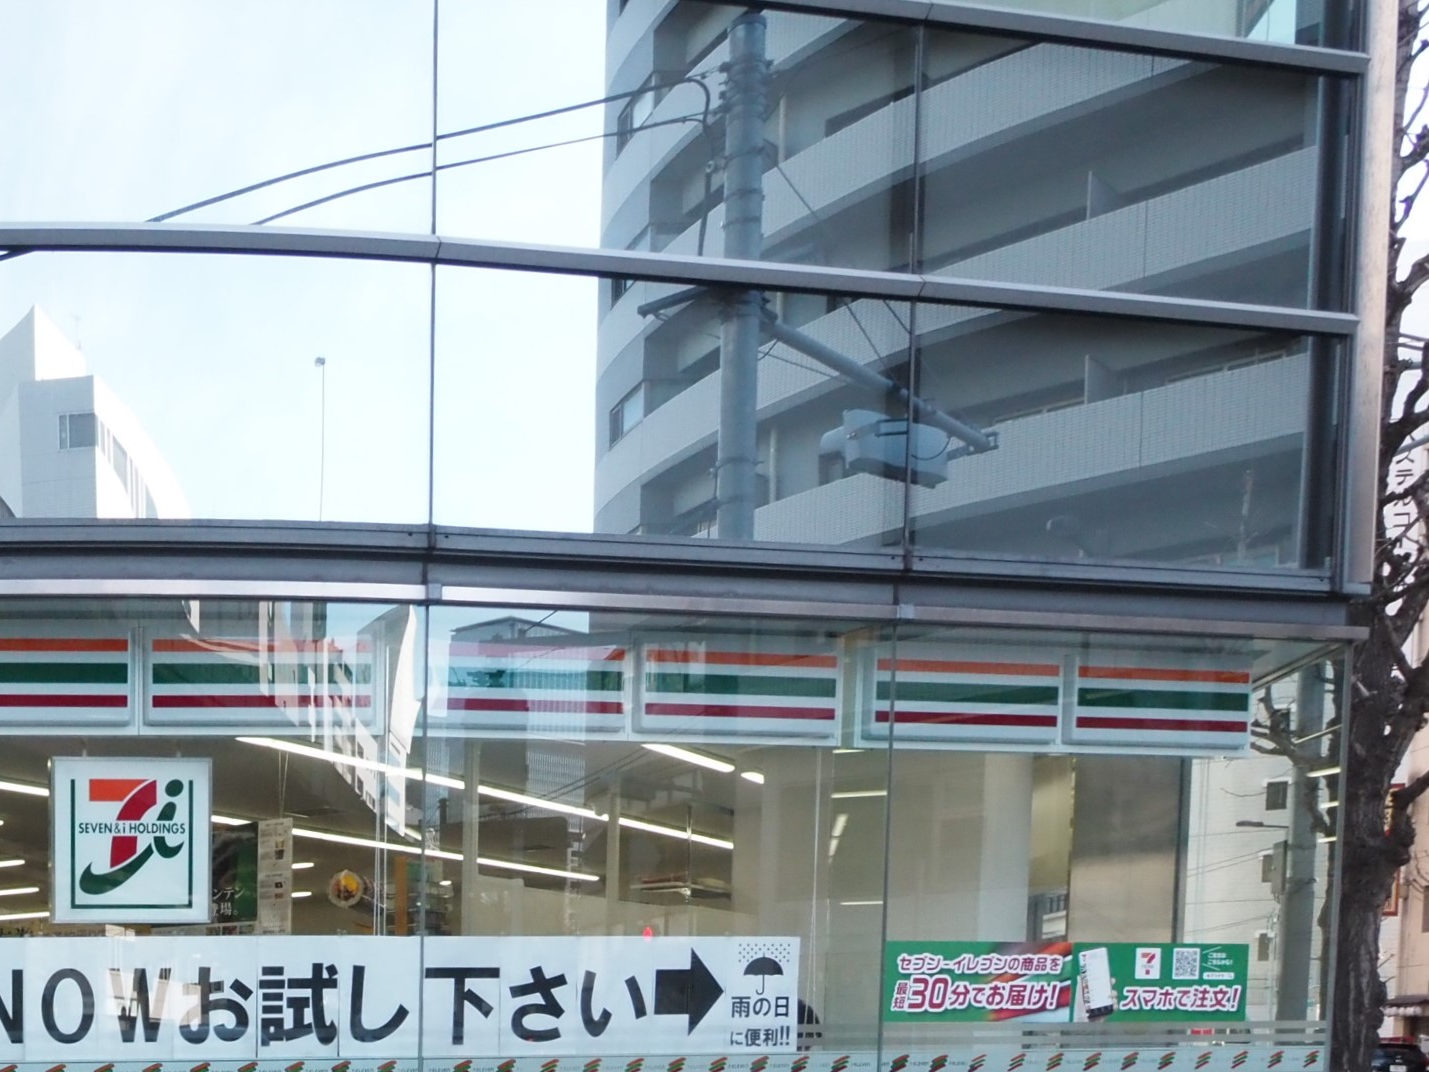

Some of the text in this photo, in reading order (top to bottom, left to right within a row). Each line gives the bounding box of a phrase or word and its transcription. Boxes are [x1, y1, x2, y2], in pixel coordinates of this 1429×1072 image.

[129, 822, 186, 835] HOLDINGS
[731, 996, 790, 1018] 雨の日
[1121, 987, 1240, 1009] スマホで注文!
[730, 1025, 790, 1047] に便利!!
